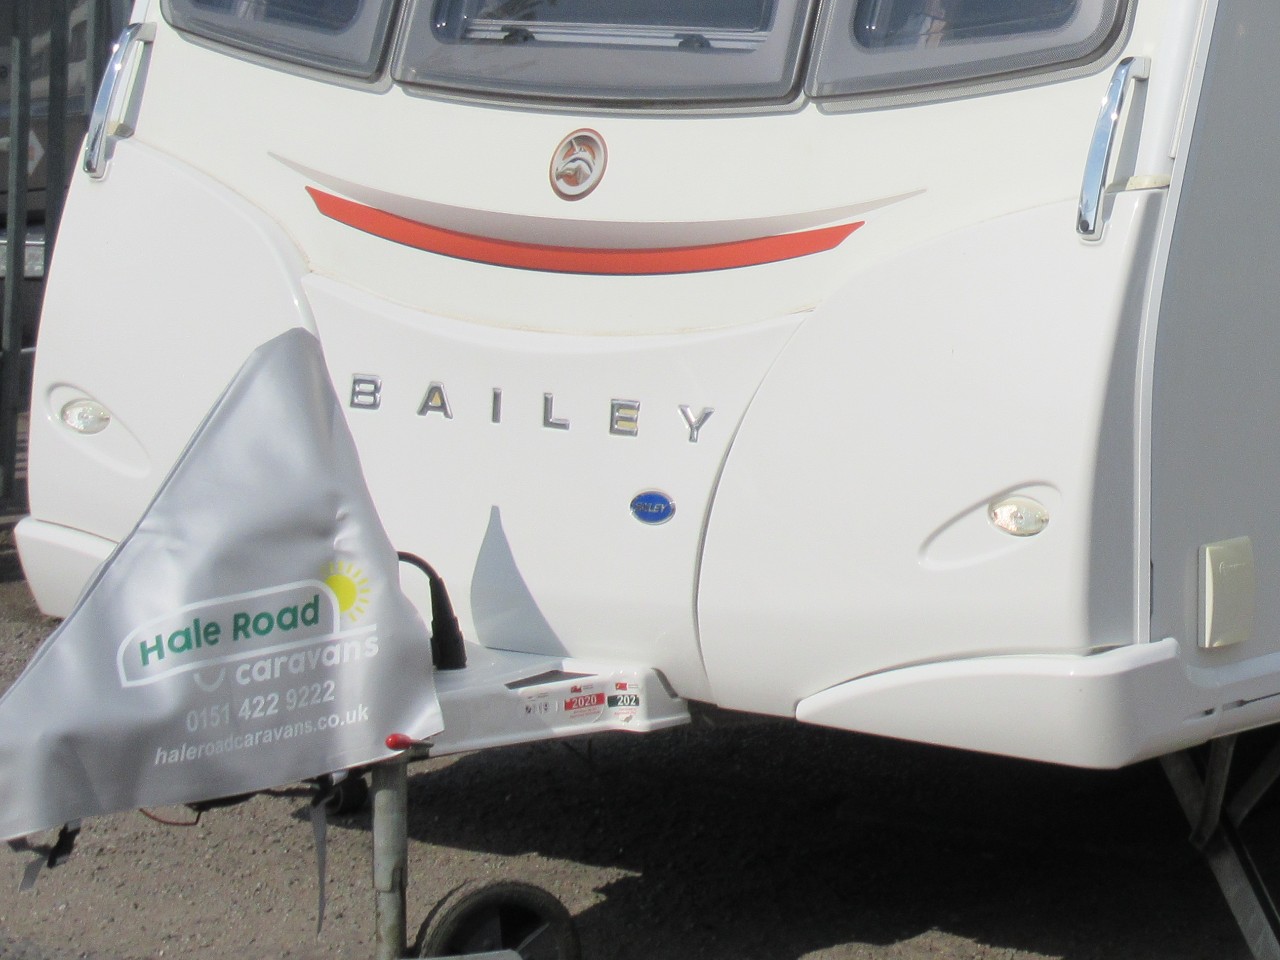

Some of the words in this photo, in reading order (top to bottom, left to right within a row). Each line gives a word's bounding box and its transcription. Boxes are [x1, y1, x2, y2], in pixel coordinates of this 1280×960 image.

[349, 373, 715, 443] BAILEY
[139, 618, 221, 667] Hale
[232, 594, 321, 642] Road
[235, 636, 380, 686] caravans
[186, 702, 230, 733] 0151
[238, 693, 280, 721] 422
[286, 680, 336, 709] 9222
[572, 695, 597, 708] 2020
[154, 703, 370, 766] haleroadcaravans.co.uk
